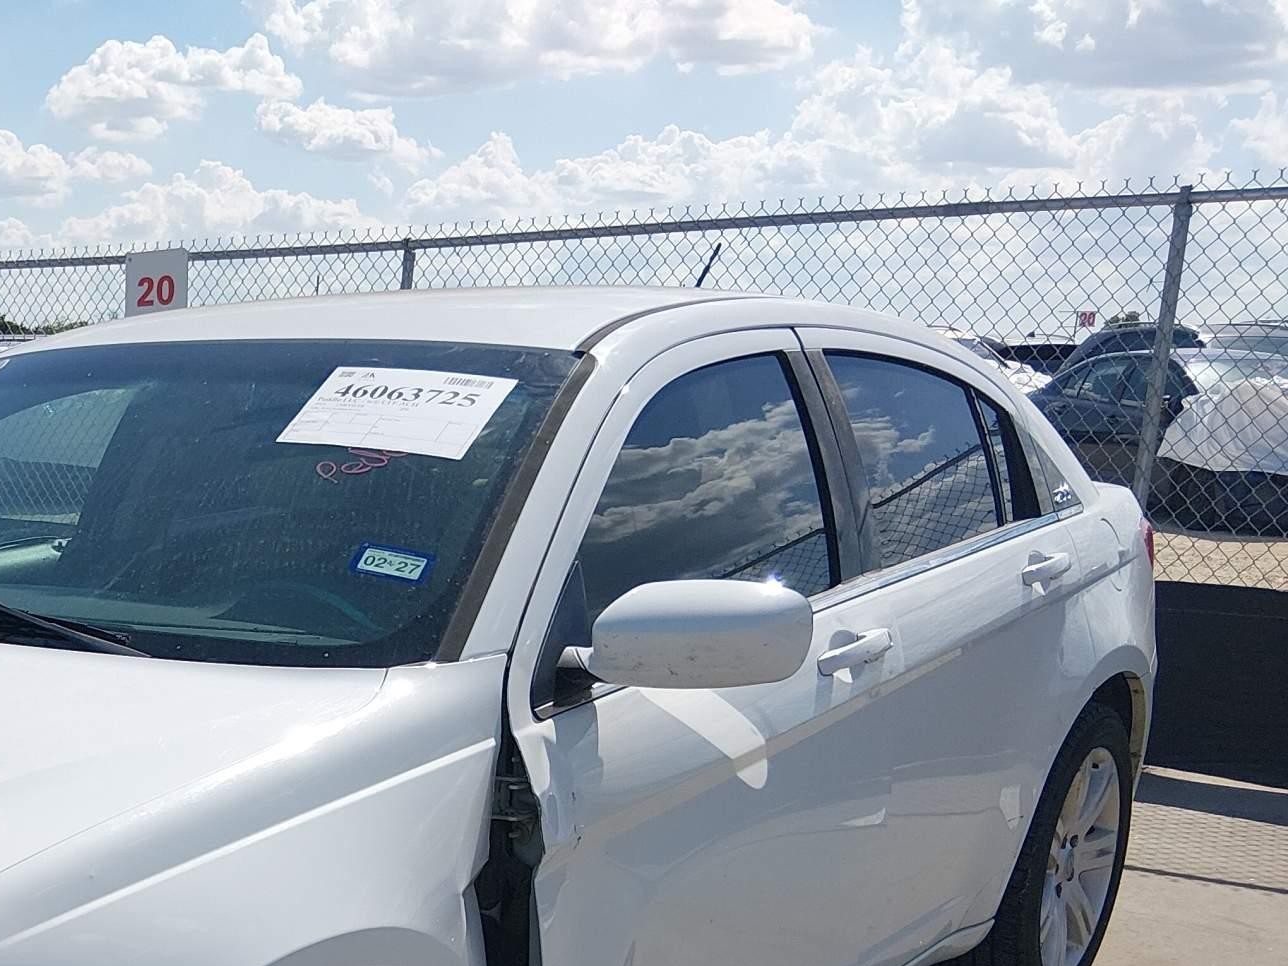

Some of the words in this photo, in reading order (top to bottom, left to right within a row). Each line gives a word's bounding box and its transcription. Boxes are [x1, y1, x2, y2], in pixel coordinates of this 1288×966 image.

[137, 275, 175, 307] 20
[334, 383, 481, 408] 46063725
[363, 555, 387, 568] 02
[394, 561, 422, 575] 27
